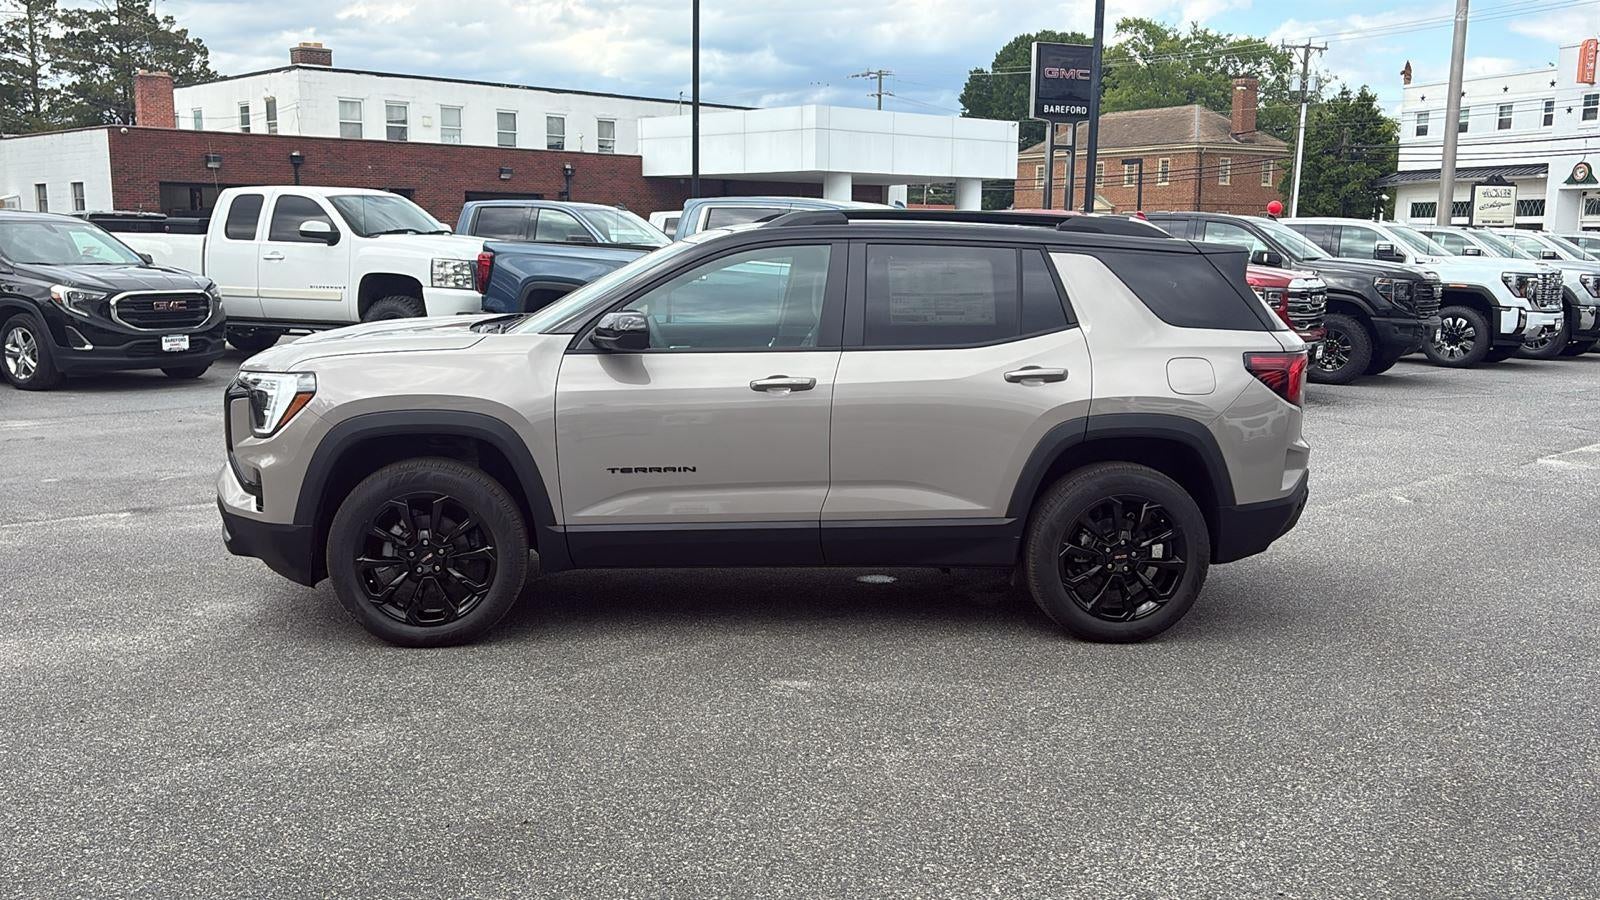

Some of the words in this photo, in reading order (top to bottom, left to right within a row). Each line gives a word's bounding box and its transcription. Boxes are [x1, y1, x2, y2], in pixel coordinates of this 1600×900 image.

[1044, 68, 1090, 80] GMC
[1043, 105, 1087, 115] BAREFORD
[606, 466, 697, 474] TERRAIN
